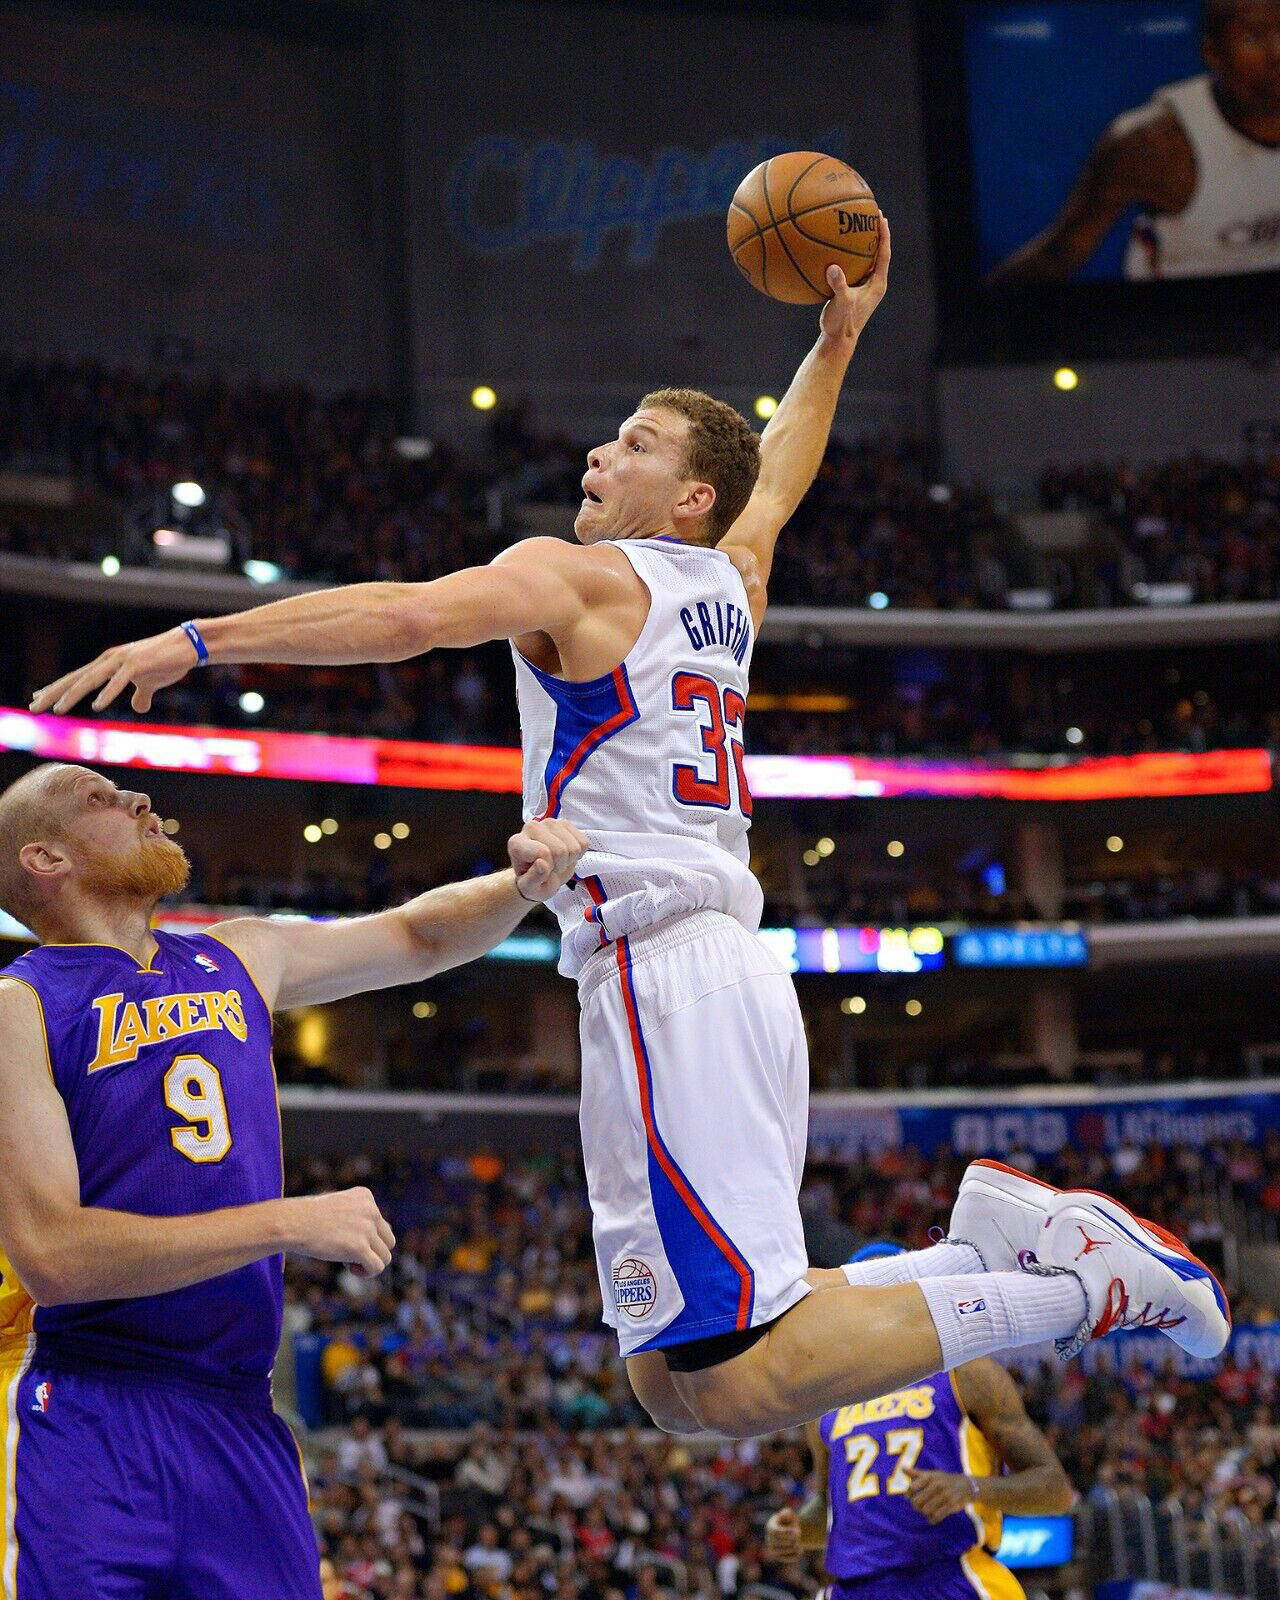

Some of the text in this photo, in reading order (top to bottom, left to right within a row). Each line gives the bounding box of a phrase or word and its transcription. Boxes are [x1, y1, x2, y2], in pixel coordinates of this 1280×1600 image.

[444, 128, 847, 272] Clippe
[679, 601, 750, 667] GRIFFIN
[672, 671, 752, 818] 32
[87, 989, 248, 1076] LAKERS
[163, 1053, 233, 1164] 9
[844, 1426, 924, 1502] 27
